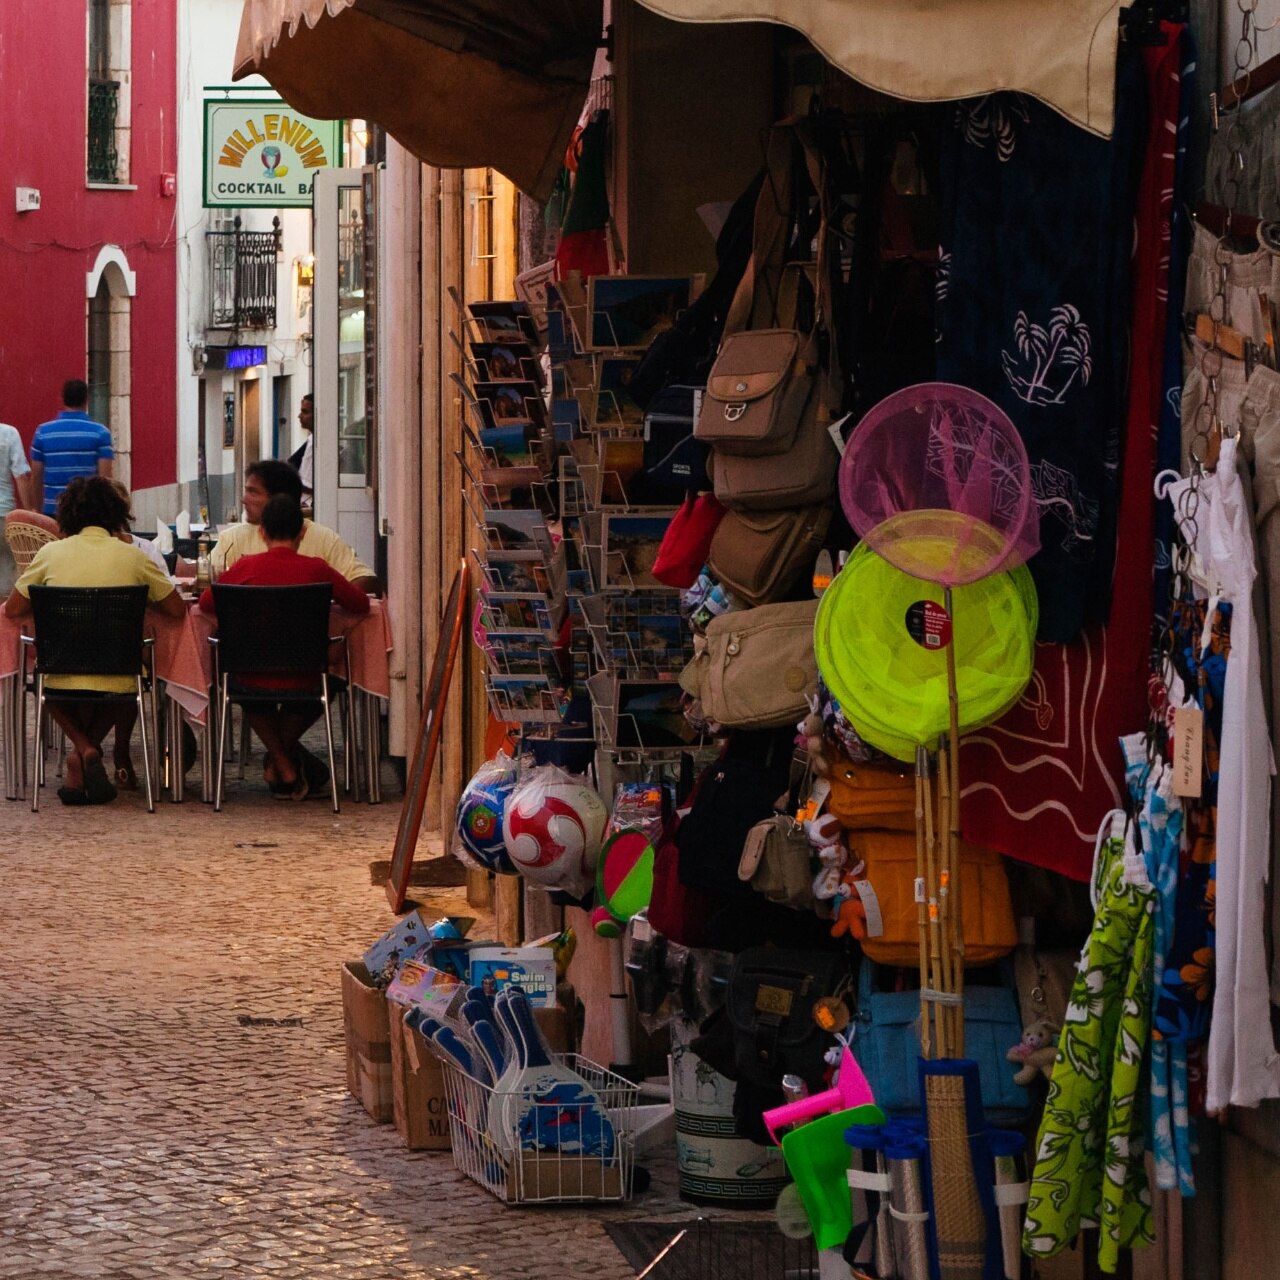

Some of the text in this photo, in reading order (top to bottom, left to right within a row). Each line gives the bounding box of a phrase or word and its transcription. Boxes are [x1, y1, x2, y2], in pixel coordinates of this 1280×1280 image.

[218, 113, 328, 169] MILLENIUM
[218, 182, 314, 195] COCKTAIL BA
[511, 971, 546, 982] Swim
